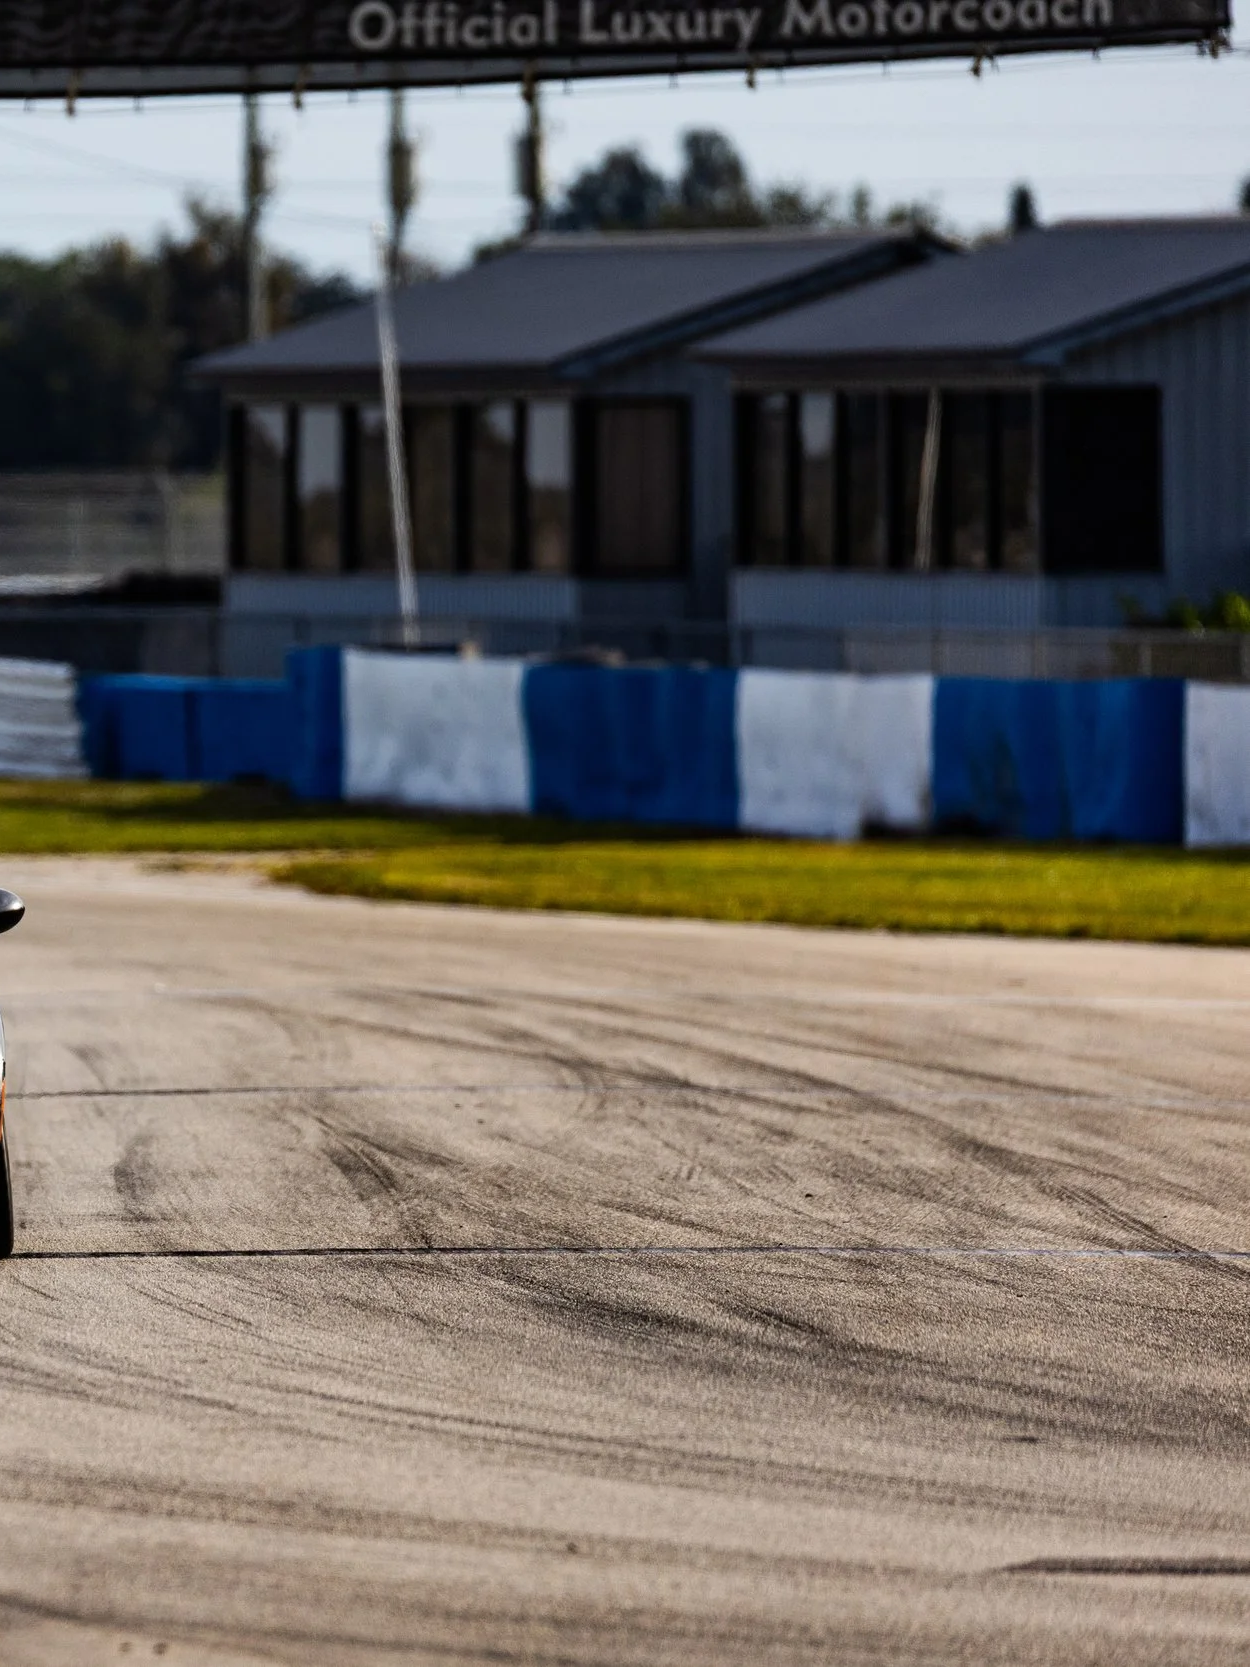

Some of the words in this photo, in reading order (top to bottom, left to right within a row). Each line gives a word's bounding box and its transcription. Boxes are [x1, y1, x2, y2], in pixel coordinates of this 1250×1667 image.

[350, 0, 557, 50] Official
[579, 0, 761, 53] Luxury
[780, 0, 1113, 38] Motorcoach
